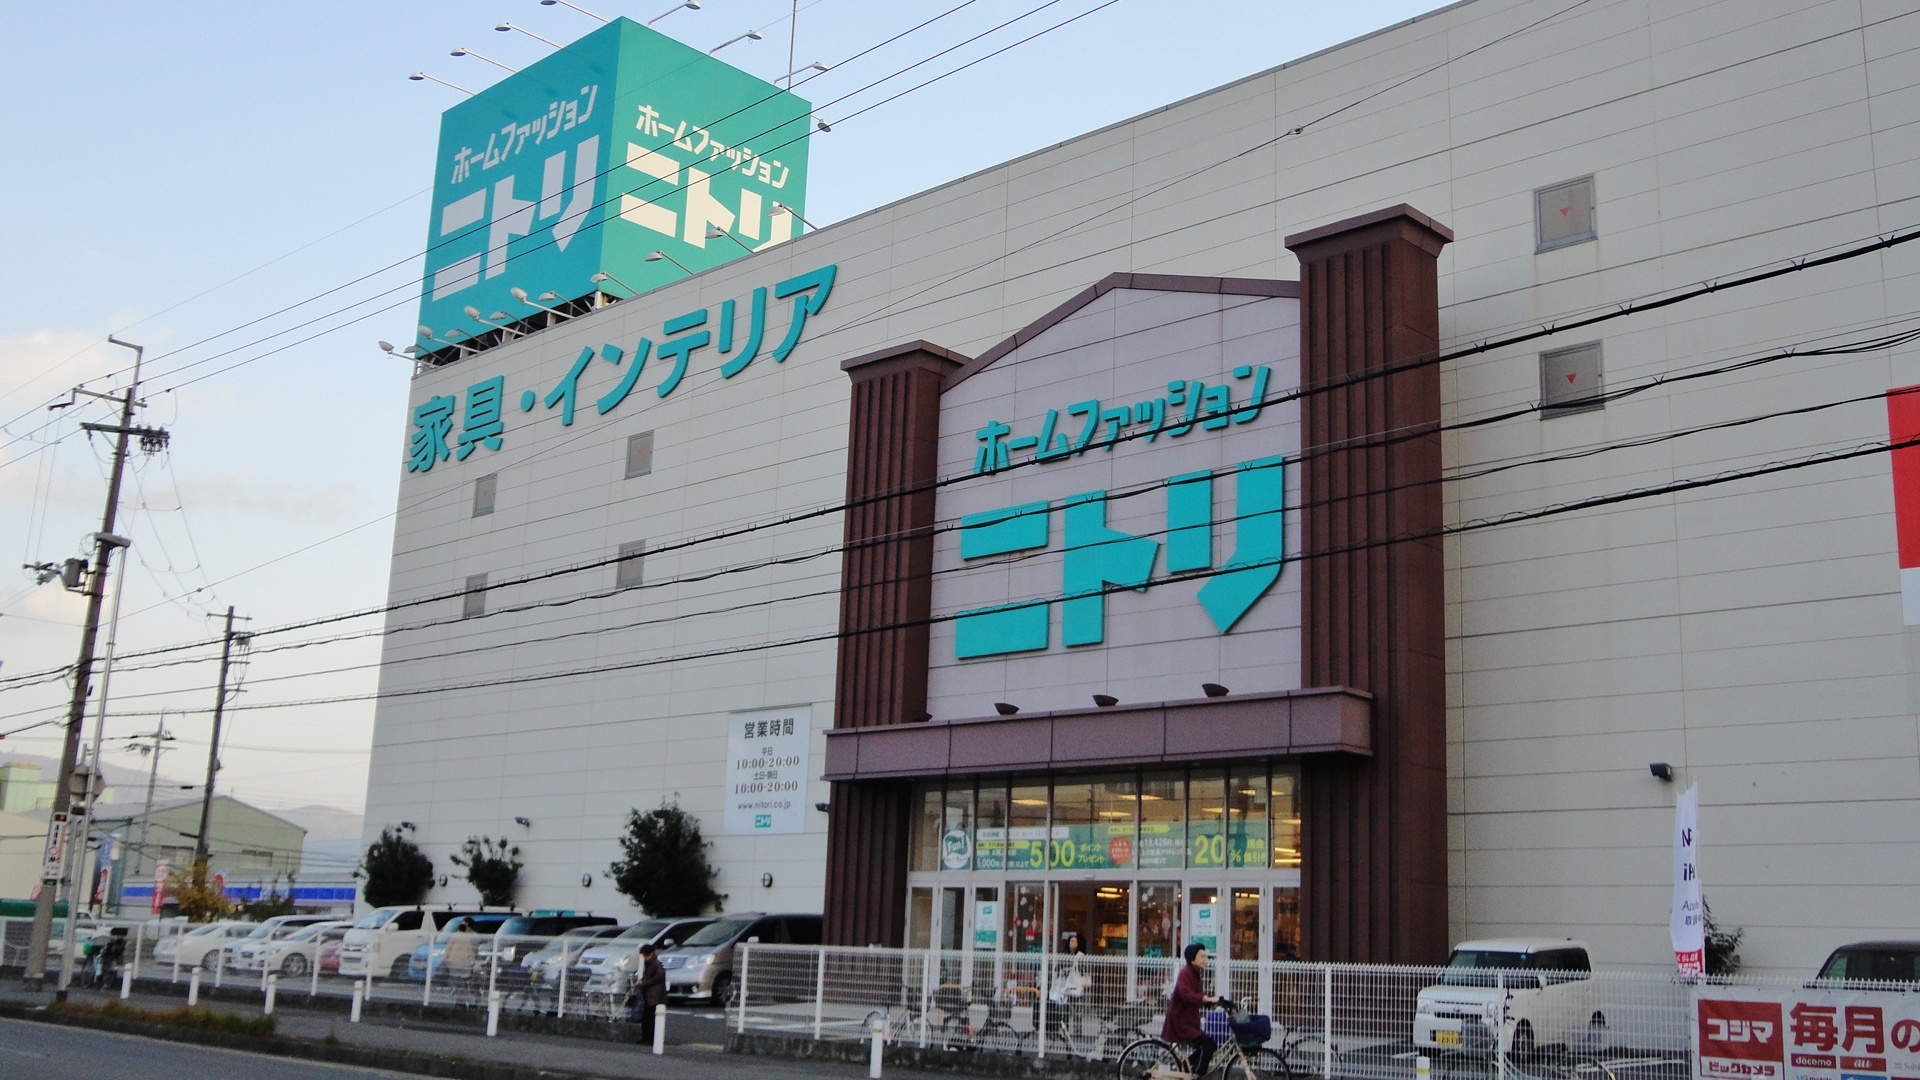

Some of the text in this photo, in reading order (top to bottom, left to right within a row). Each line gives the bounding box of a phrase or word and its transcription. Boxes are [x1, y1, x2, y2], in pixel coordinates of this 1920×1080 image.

[451, 84, 599, 185] ホームファッション
[636, 104, 790, 189] ホームファッション
[431, 135, 599, 302] ニトリ
[620, 142, 793, 253] ニトリ
[407, 264, 838, 473] 家具・インテリア
[973, 365, 1271, 475] ホームファッション
[954, 455, 1285, 660] ニトリ
[744, 718, 795, 739] 営業時間
[737, 799, 791, 810] www.nitori.co.jp
[1707, 1018, 1774, 1044] コジマ
[1709, 1060, 1775, 1076] ビックカメラ
[1795, 1056, 1832, 1067] docomo
[1853, 1059, 1873, 1068] au
